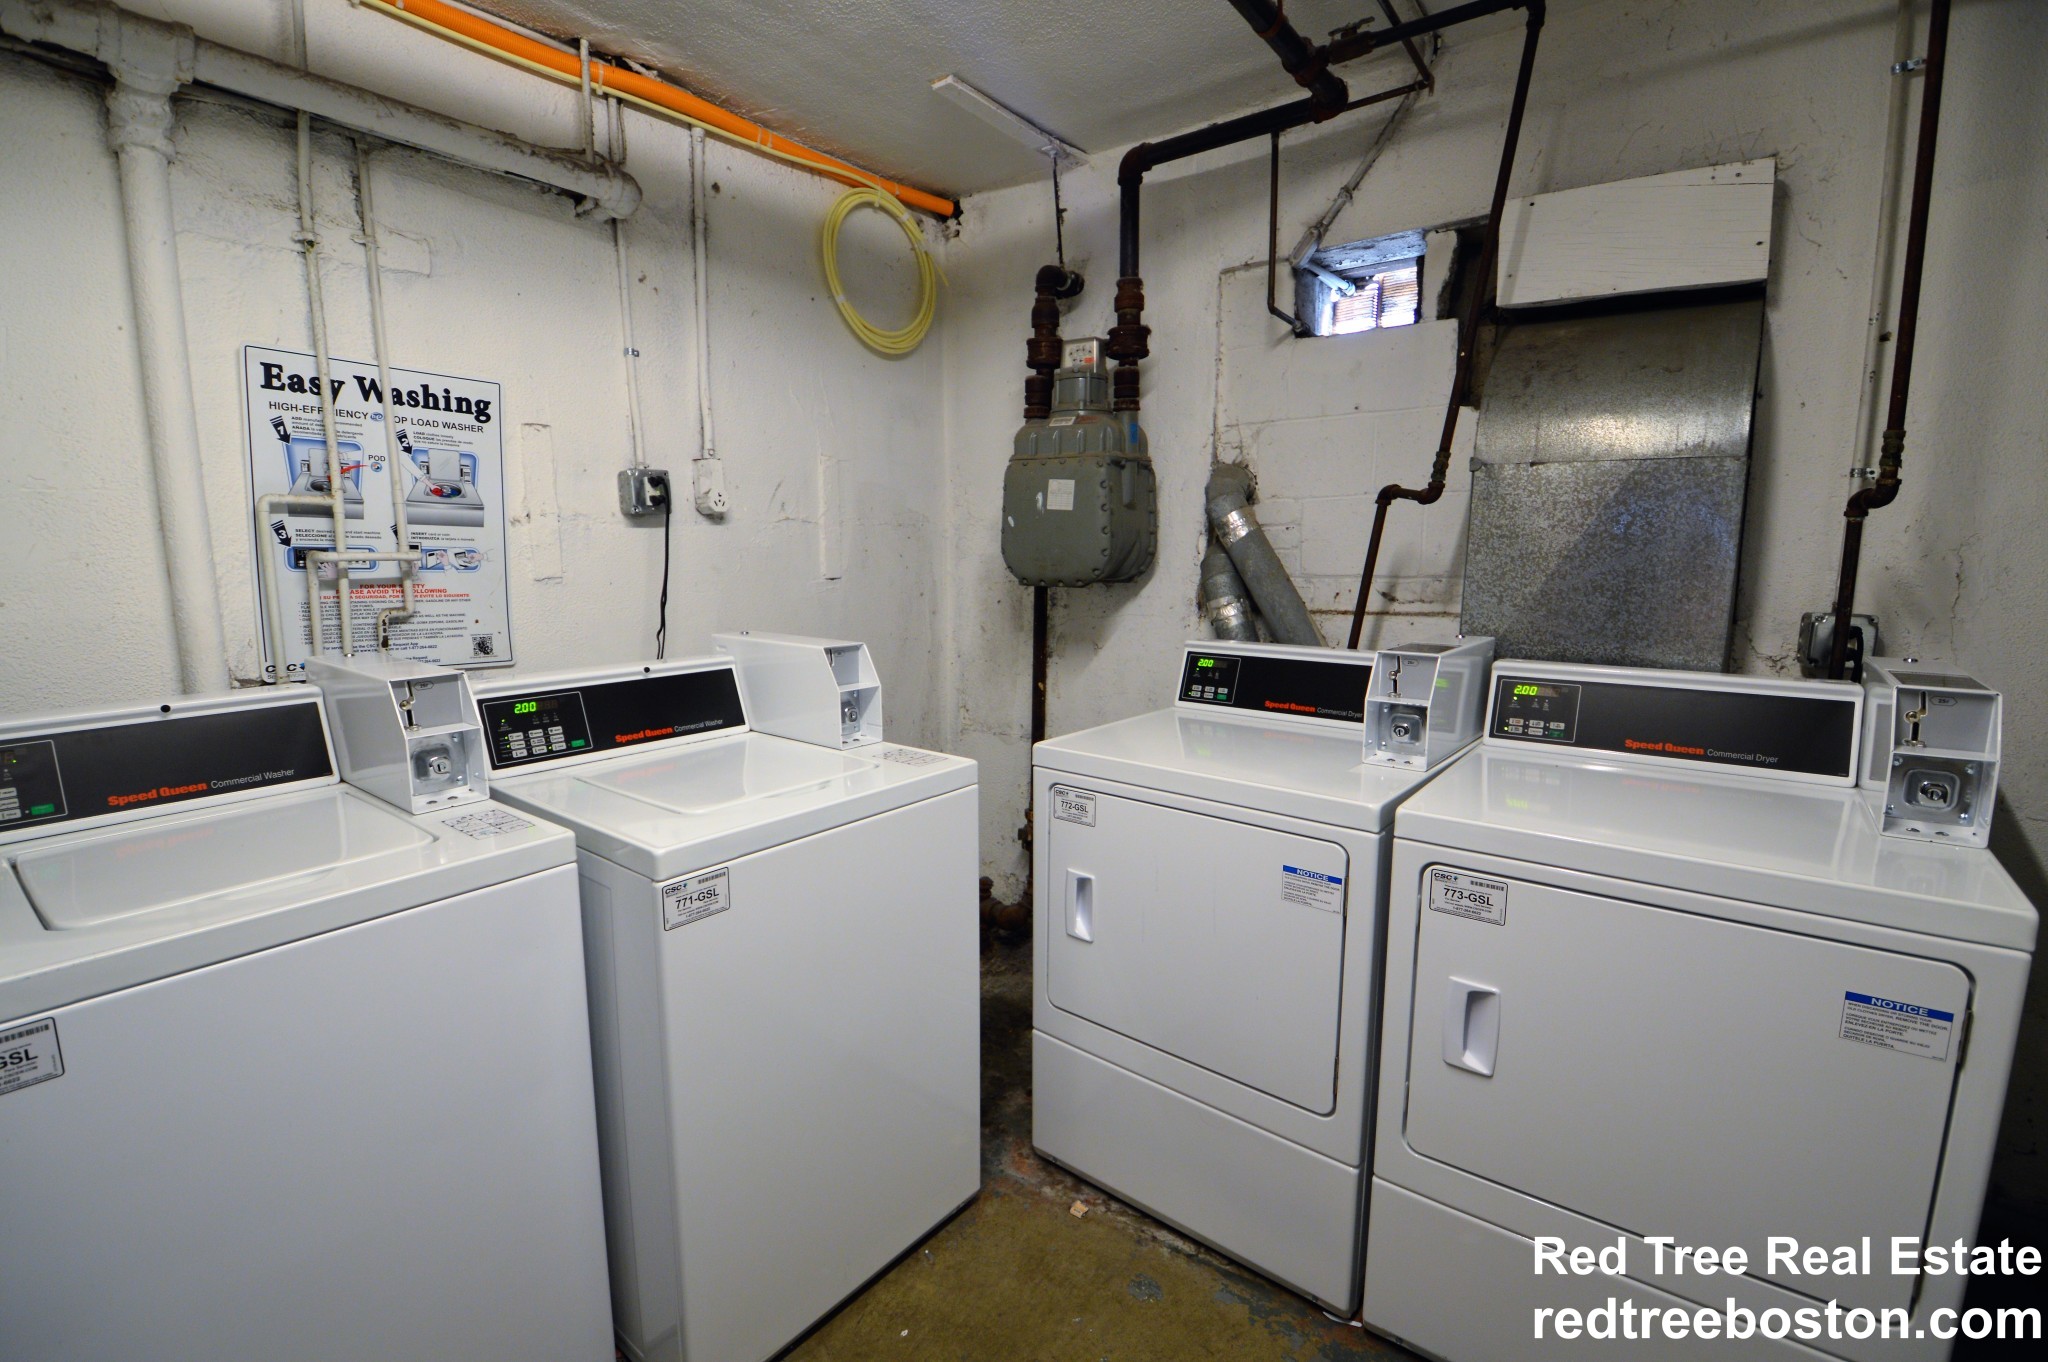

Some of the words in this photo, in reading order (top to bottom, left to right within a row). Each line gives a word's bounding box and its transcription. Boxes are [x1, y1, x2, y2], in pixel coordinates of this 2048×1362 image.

[260, 361, 345, 404] Easy
[353, 374, 492, 424] Washing
[269, 401, 368, 420] HIGH-EFFIENCY
[411, 418, 439, 428] LOAD
[442, 422, 484, 434] WASHER
[266, 663, 297, 673] CC
[1514, 685, 1538, 695] 2.00
[514, 701, 536, 714] 2.00
[1265, 700, 1289, 711] Speed
[1290, 702, 1315, 713] Queen
[1317, 707, 1347, 716] Commercial
[1348, 710, 1363, 719] Dryer
[614, 730, 644, 744] Speed
[645, 726, 673, 738] Queen
[673, 722, 704, 733] Commercial
[705, 718, 723, 727] Washer
[1625, 739, 1662, 751] Speed
[1665, 742, 1704, 755] Queen
[1707, 749, 1754, 761] Commercial
[1755, 753, 1778, 764] Dryer
[107, 788, 157, 807] Speed
[160, 782, 207, 798] Queen
[210, 772, 262, 789] Commercial
[263, 767, 295, 780] Washer
[1061, 801, 1088, 813] 772-GSL
[1296, 868, 1329, 882] NOTICE
[665, 885, 682, 894] CSC
[676, 888, 719, 909] 771-GSL
[1444, 888, 1494, 906] 773-GSL
[1871, 998, 1928, 1016] NOTICE
